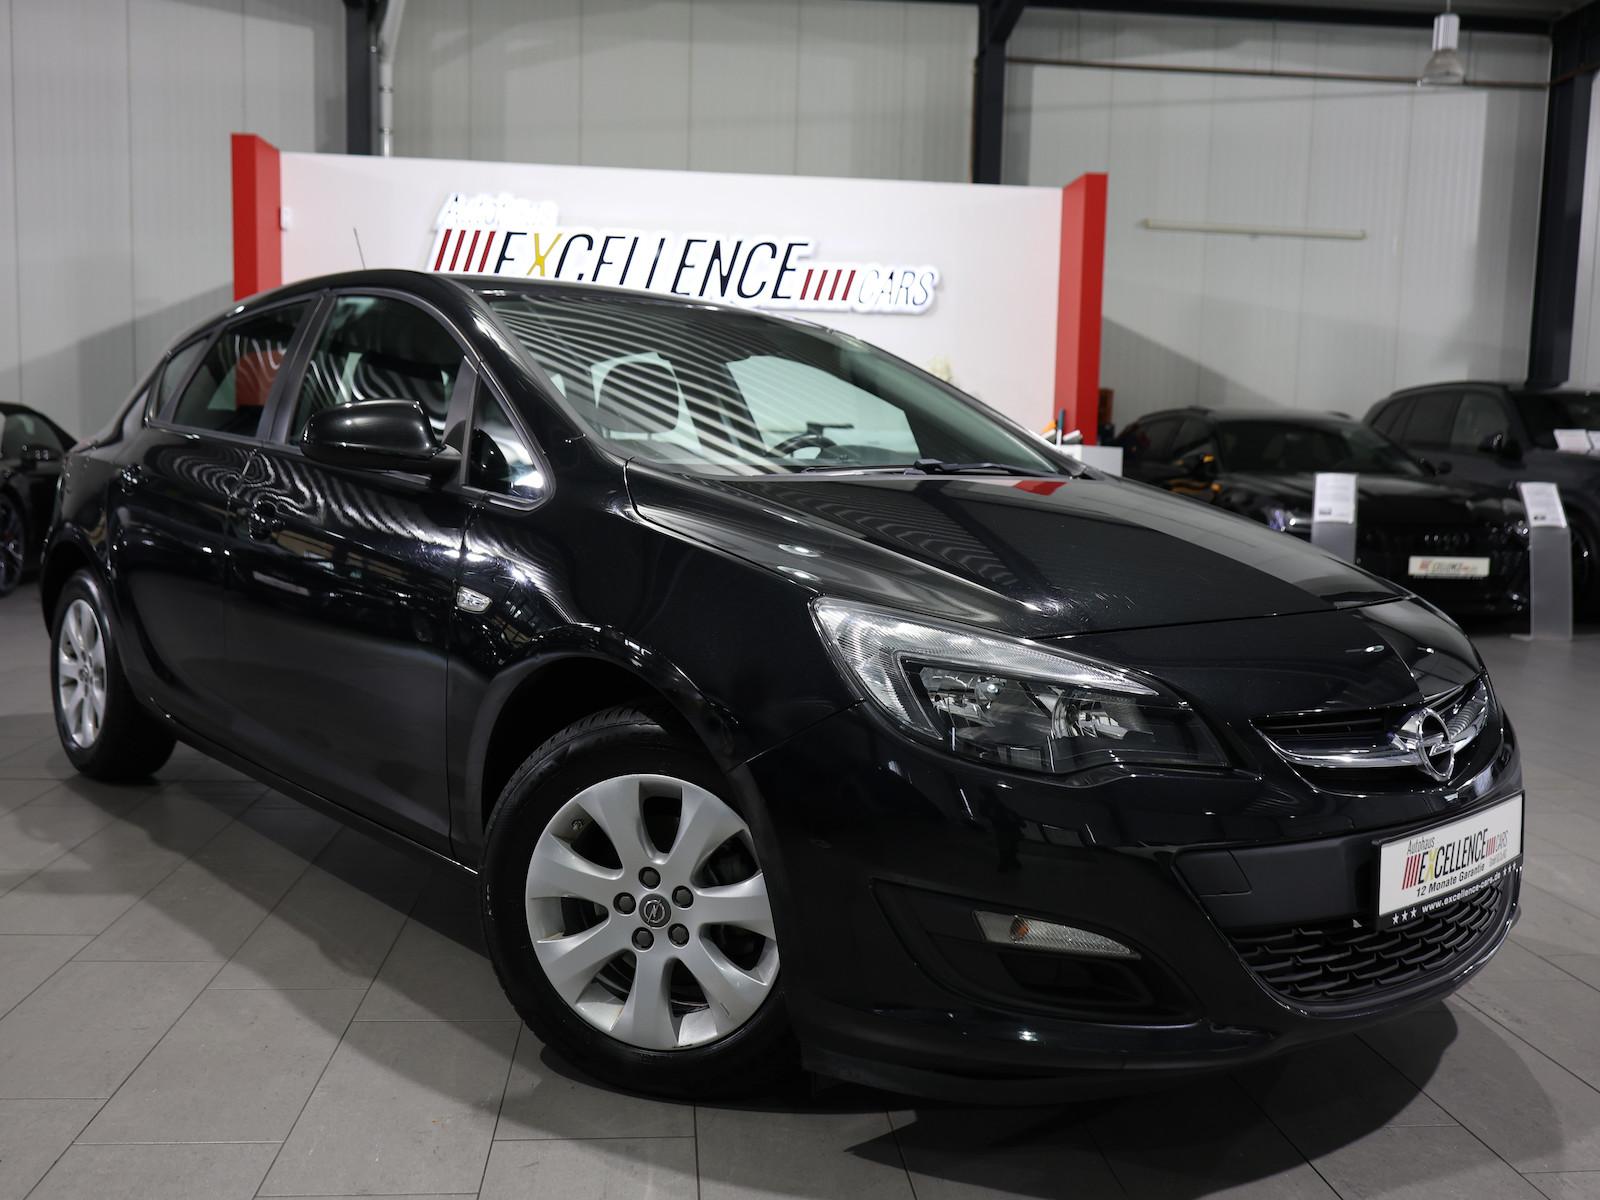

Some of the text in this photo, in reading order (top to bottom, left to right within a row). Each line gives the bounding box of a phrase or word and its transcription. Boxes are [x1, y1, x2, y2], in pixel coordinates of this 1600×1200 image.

[494, 231, 936, 306] EXCELLENCE CARS
[1407, 836, 1435, 855] Autohaus
[1418, 828, 1488, 885] EXCELLENCE
[1416, 863, 1485, 897] 12 Monate Garantie
